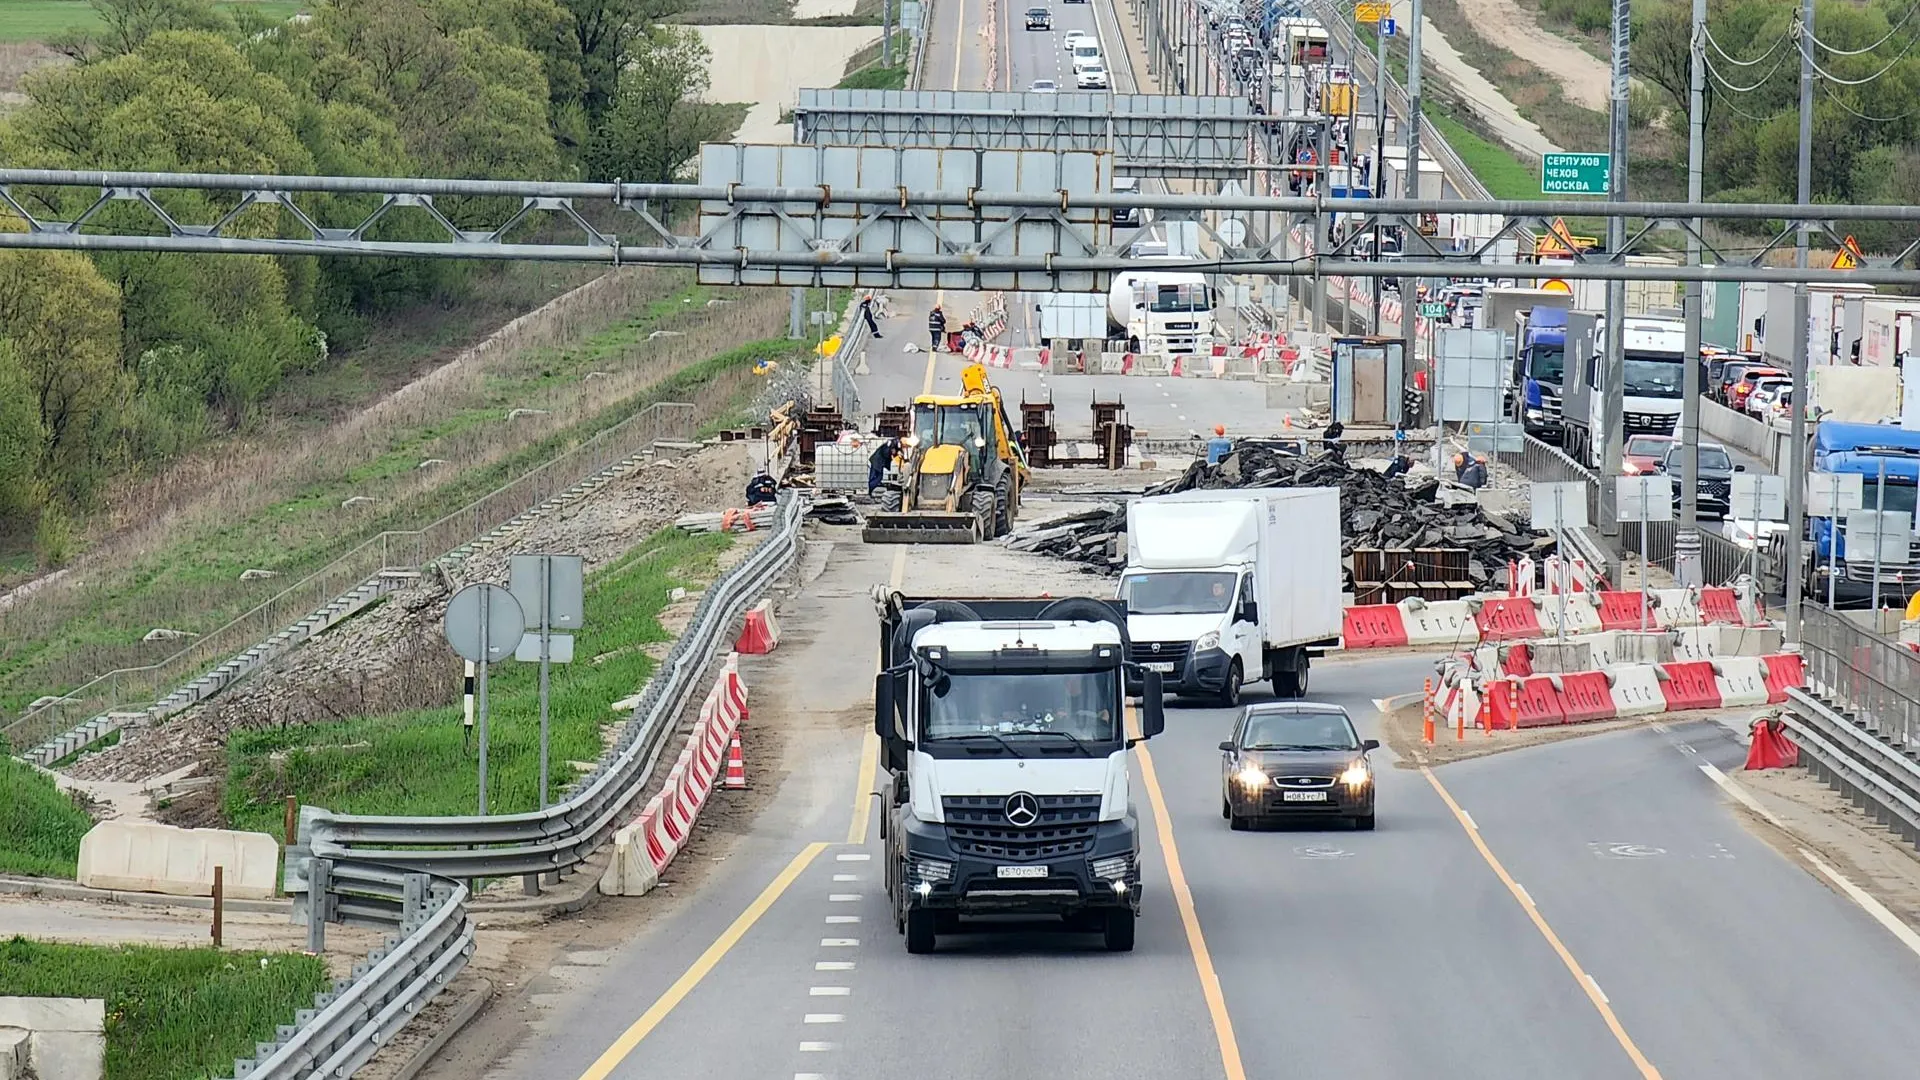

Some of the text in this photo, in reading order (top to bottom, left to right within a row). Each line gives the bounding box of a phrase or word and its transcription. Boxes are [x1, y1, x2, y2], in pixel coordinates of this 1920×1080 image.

[1546, 156, 1600, 167] СЕРПУХОВ
[1546, 168, 1579, 178] ЧЕХОВ
[1546, 180, 1590, 190] МОСКВА
[1425, 305, 1442, 313] 104
[1419, 616, 1457, 632] ЕТС
